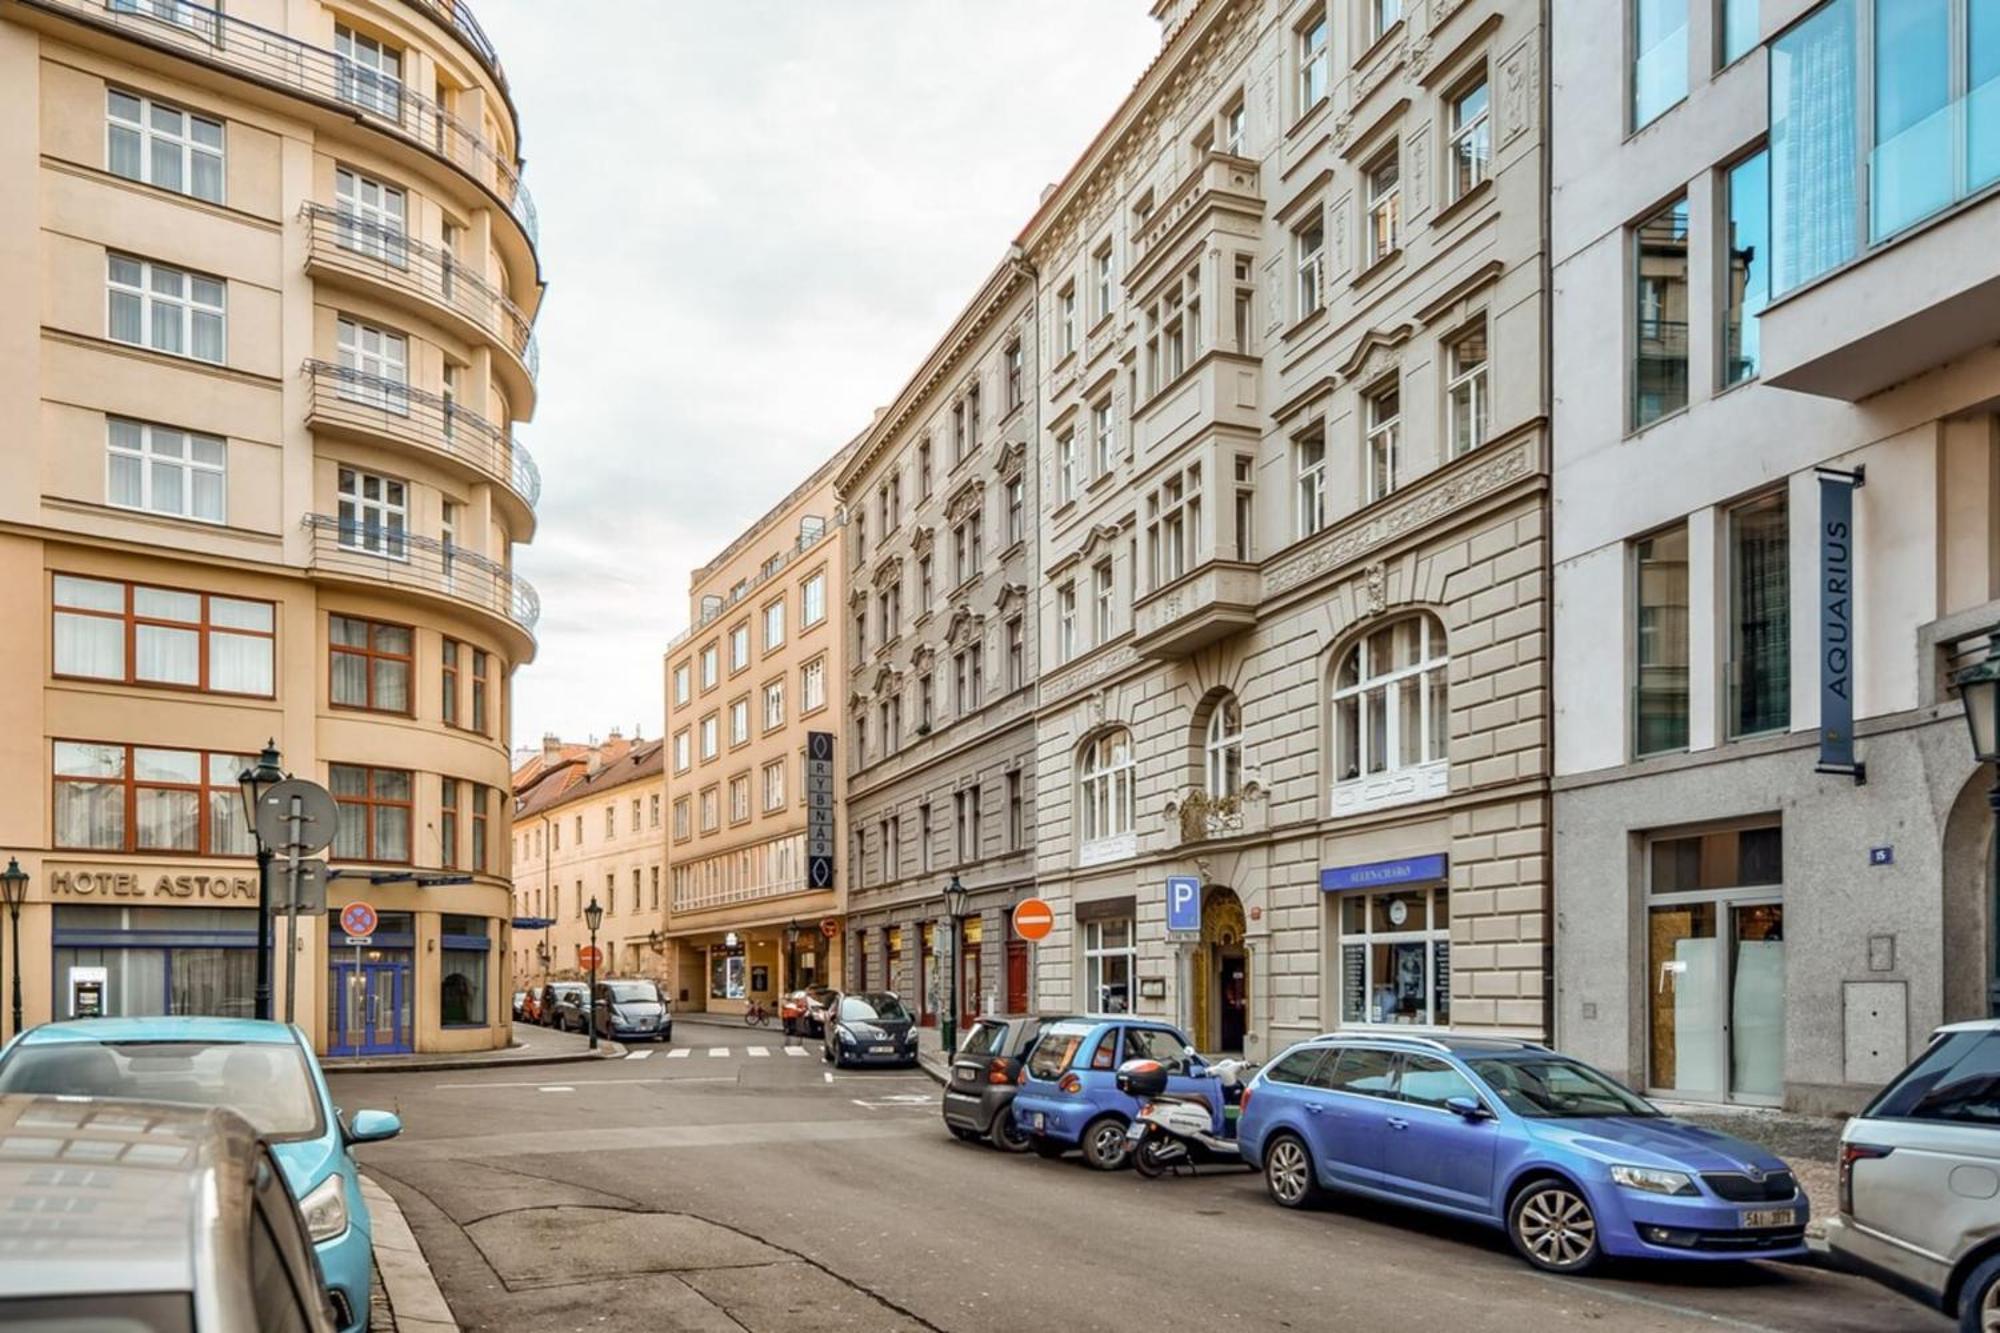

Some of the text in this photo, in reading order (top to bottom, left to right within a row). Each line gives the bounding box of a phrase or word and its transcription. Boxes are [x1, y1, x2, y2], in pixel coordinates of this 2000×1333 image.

[1827, 521, 1848, 700] AQUARIUS
[51, 871, 257, 899] HOTEL ASTORI
[1174, 883, 1193, 913] P
